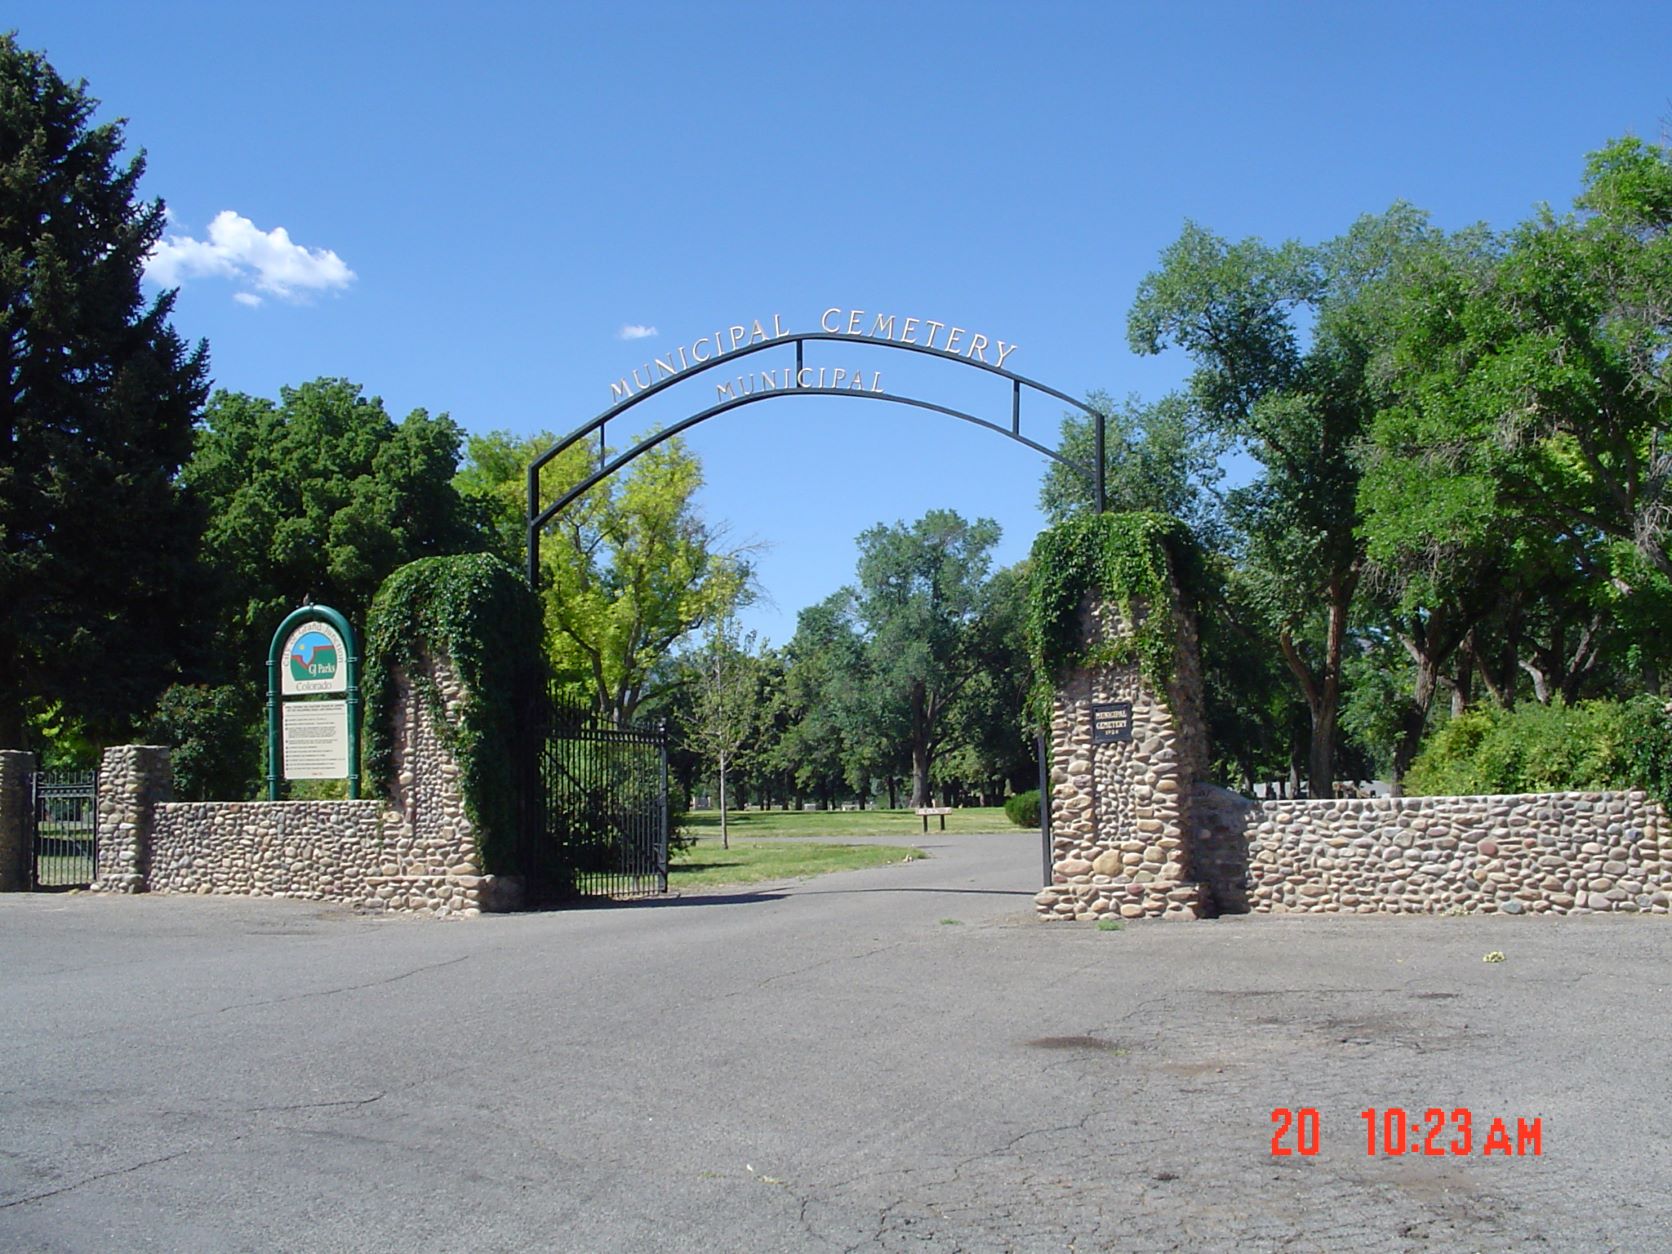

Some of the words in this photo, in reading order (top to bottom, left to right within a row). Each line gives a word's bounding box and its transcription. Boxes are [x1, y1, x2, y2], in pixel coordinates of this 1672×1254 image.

[610, 313, 791, 404] MUNICIPAL
[821, 308, 1018, 369] CEMETERY
[715, 367, 885, 403] MUNICIPAL
[318, 662, 335, 674] Parks
[296, 681, 332, 692] Colorado
